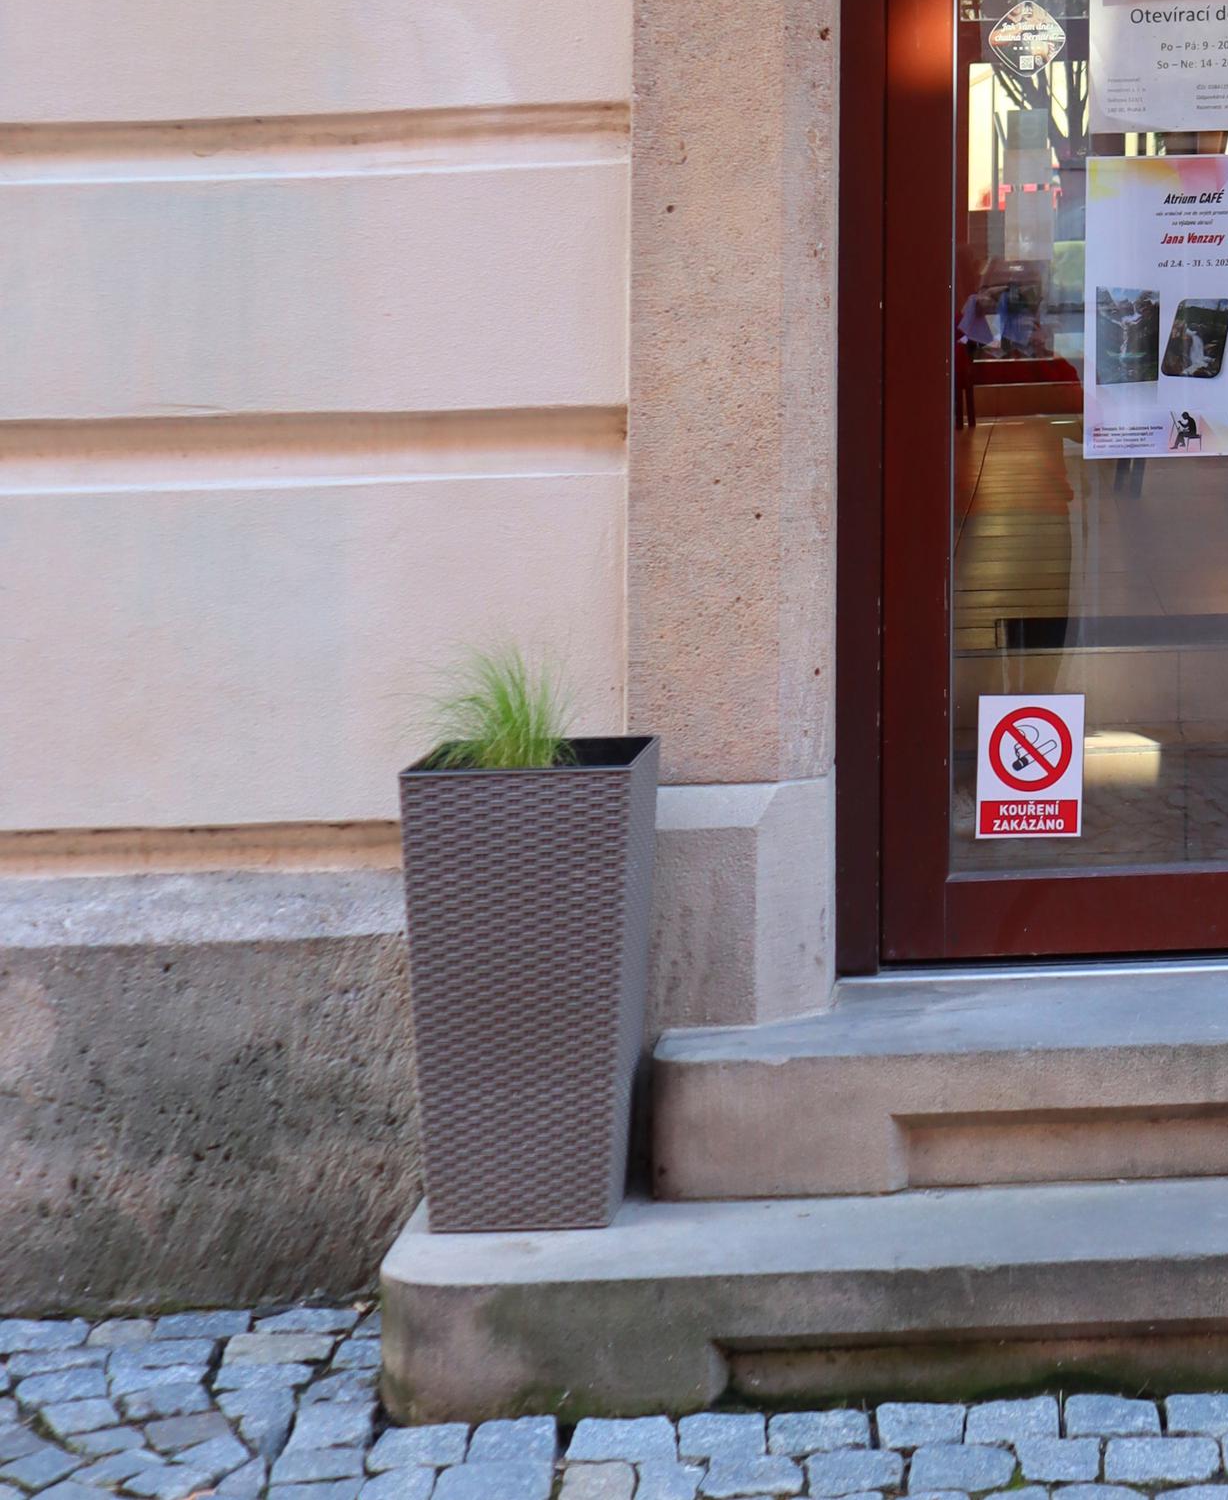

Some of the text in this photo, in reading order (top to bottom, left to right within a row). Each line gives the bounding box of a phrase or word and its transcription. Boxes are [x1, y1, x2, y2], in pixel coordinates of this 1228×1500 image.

[1130, 6, 1211, 24] Otevírací
[1160, 42, 1173, 51] Po
[1185, 41, 1199, 51] Pá:
[1202, 41, 1208, 50] 9
[1157, 60, 1169, 69] So
[1180, 59, 1197, 69] Ne:
[1201, 59, 1212, 68] 14
[1163, 189, 1225, 204] Atrium CAFÉ
[1160, 232, 1225, 246] Jana Venzary
[1000, 801, 1059, 816] KOUŘENÍ
[993, 816, 1064, 831] ZAKÁZÁNO
